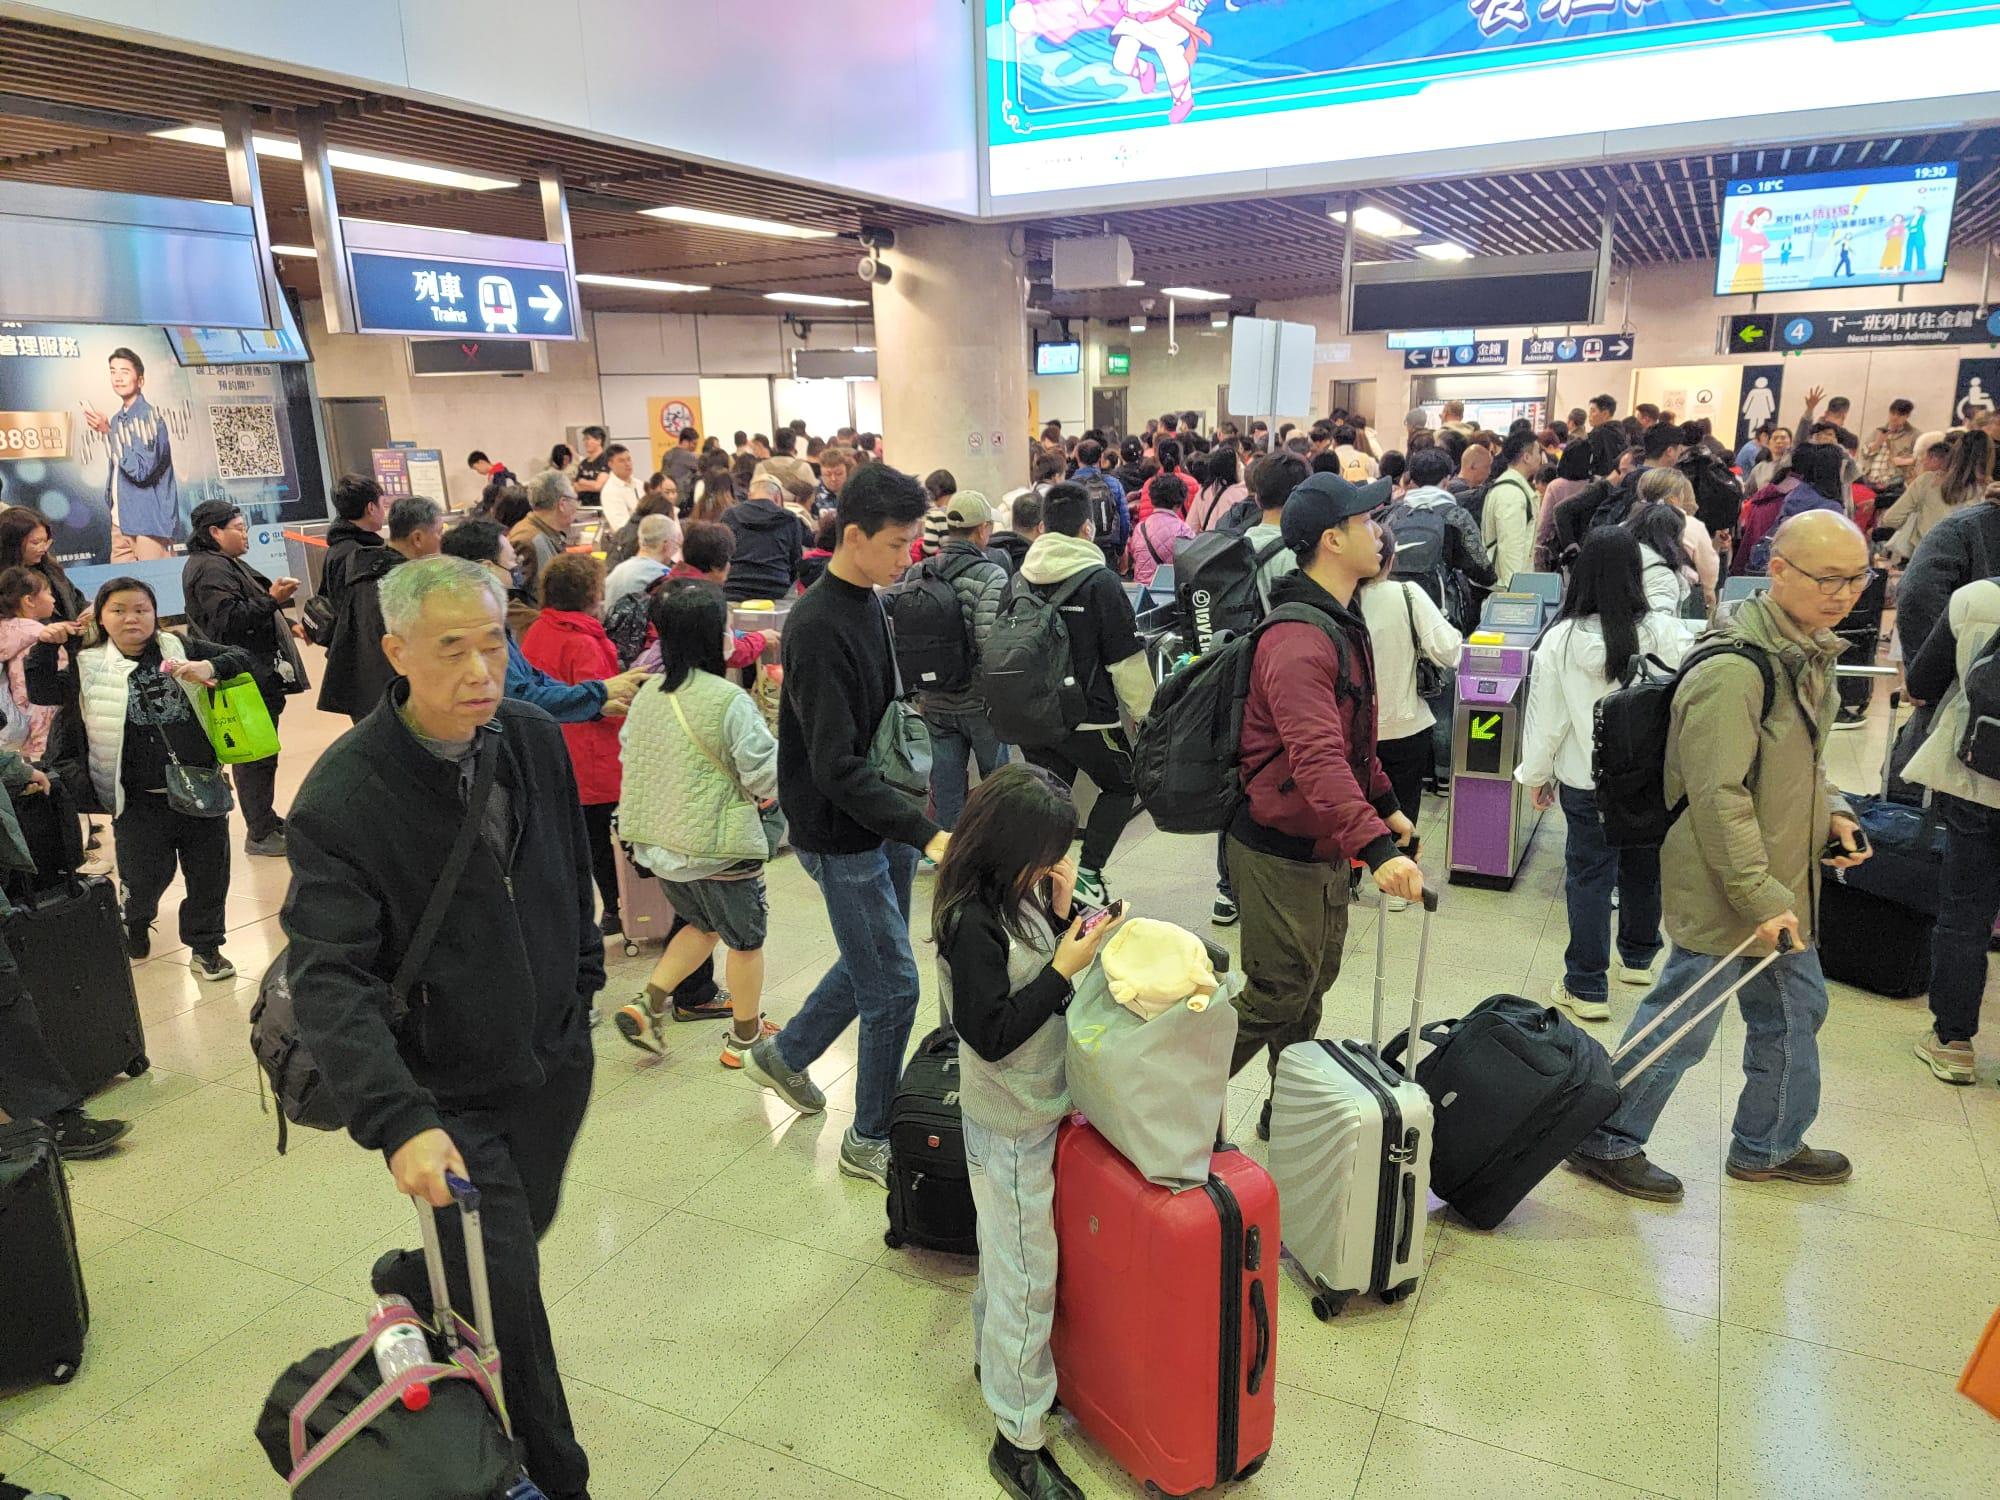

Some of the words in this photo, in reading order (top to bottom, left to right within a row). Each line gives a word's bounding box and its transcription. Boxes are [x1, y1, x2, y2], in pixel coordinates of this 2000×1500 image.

[1914, 166, 1948, 179] 19:30
[1758, 179, 1785, 192] 18°C
[412, 270, 464, 304] 列車
[430, 306, 468, 323] Trains
[1828, 311, 1974, 333] 下一班列車往金鐘
[1791, 324, 1804, 340] 4
[1847, 333, 1869, 343] Next
[1870, 333, 1891, 342] train
[1893, 333, 1903, 341] to
[1904, 331, 1950, 341] Admiralty
[0, 335, 79, 357] 管理服務
[1477, 343, 1501, 355] 金鐘
[1530, 341, 1554, 353] 金鐘
[1460, 348, 1469, 360] 4
[1476, 355, 1504, 363] Admiralty
[1524, 354, 1553, 362] Admiralty
